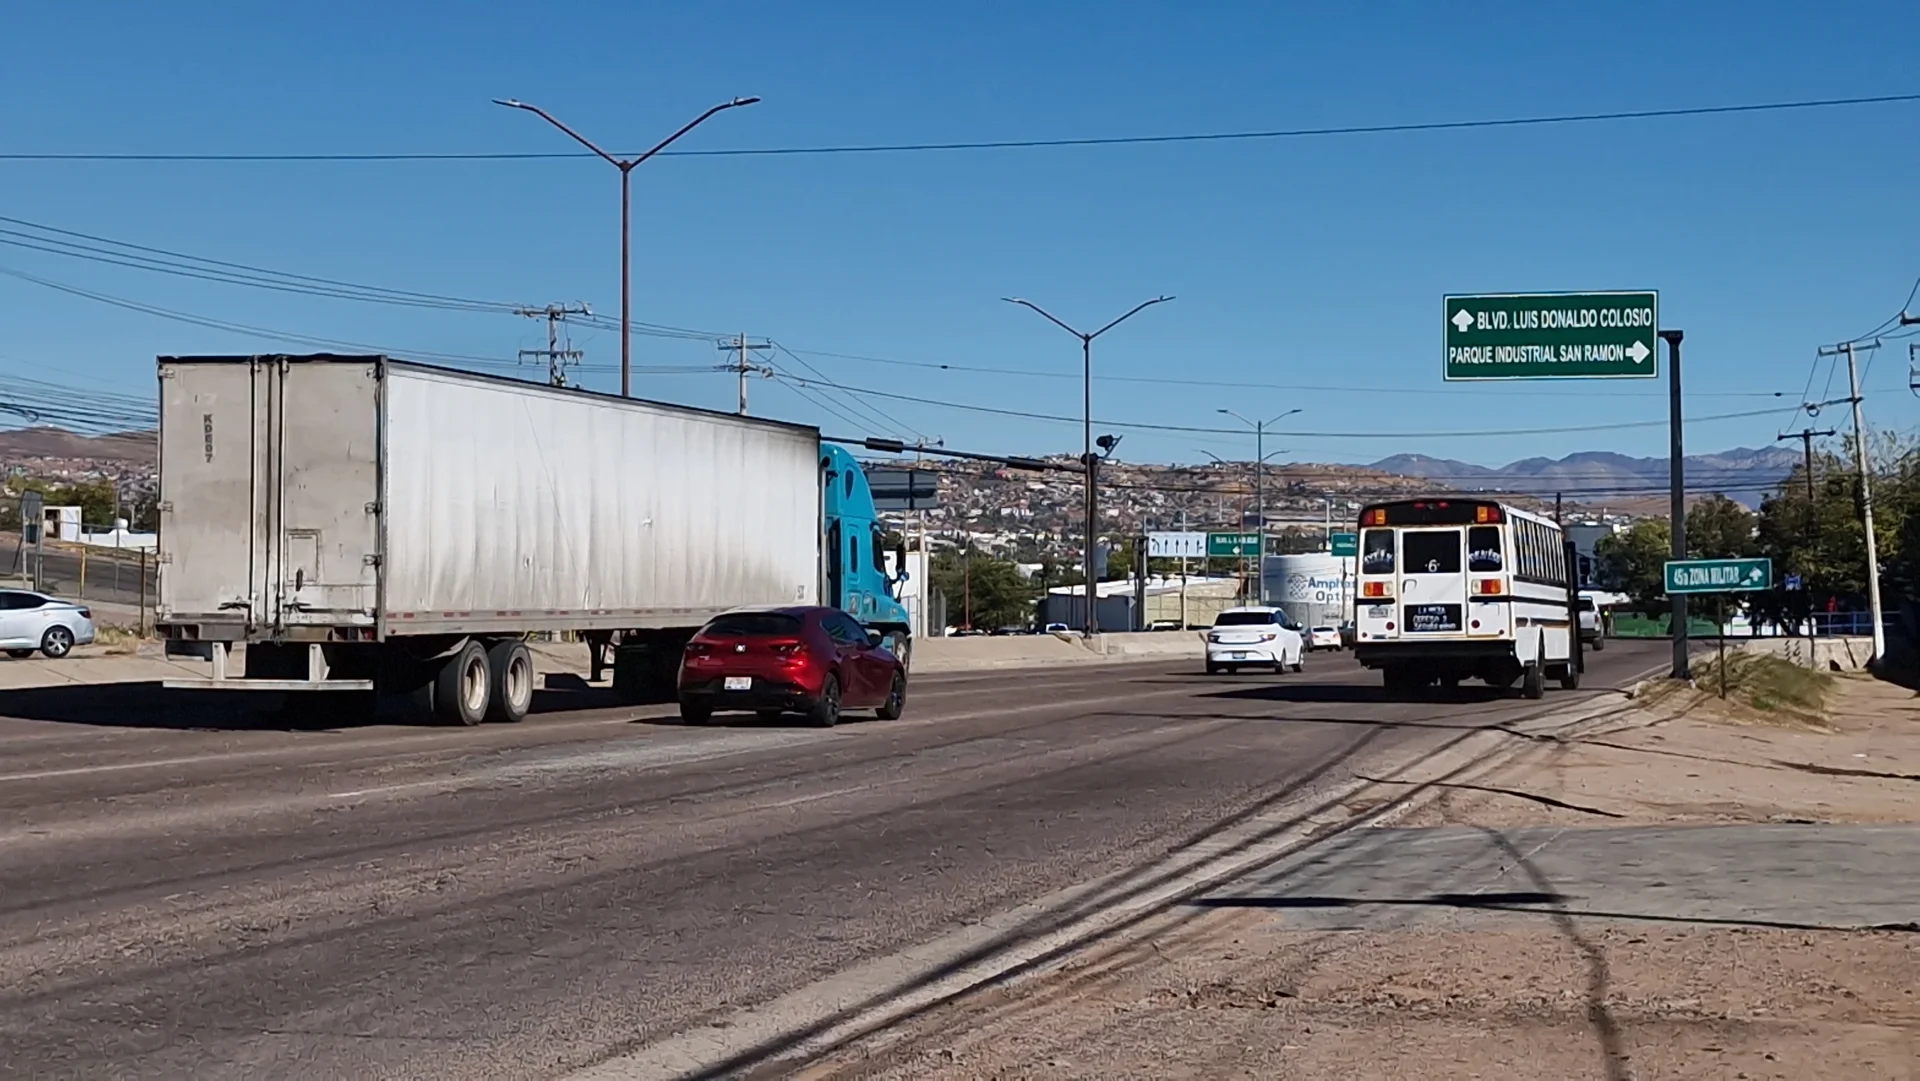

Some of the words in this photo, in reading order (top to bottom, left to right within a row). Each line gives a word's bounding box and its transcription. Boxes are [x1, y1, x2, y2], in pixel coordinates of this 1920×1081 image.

[1477, 311, 1511, 330] BLVD.
[1513, 310, 1539, 329] LUIS
[1541, 309, 1597, 328] DONALDO
[1600, 308, 1652, 327] COLOSIO
[1449, 346, 1493, 364] PARQUE
[1495, 345, 1557, 363] INDUSTRIAL
[1560, 345, 1582, 362] SAN
[1584, 344, 1624, 361] RAMON
[1689, 567, 1710, 585] ZONA
[1710, 566, 1740, 585] MILITAR
